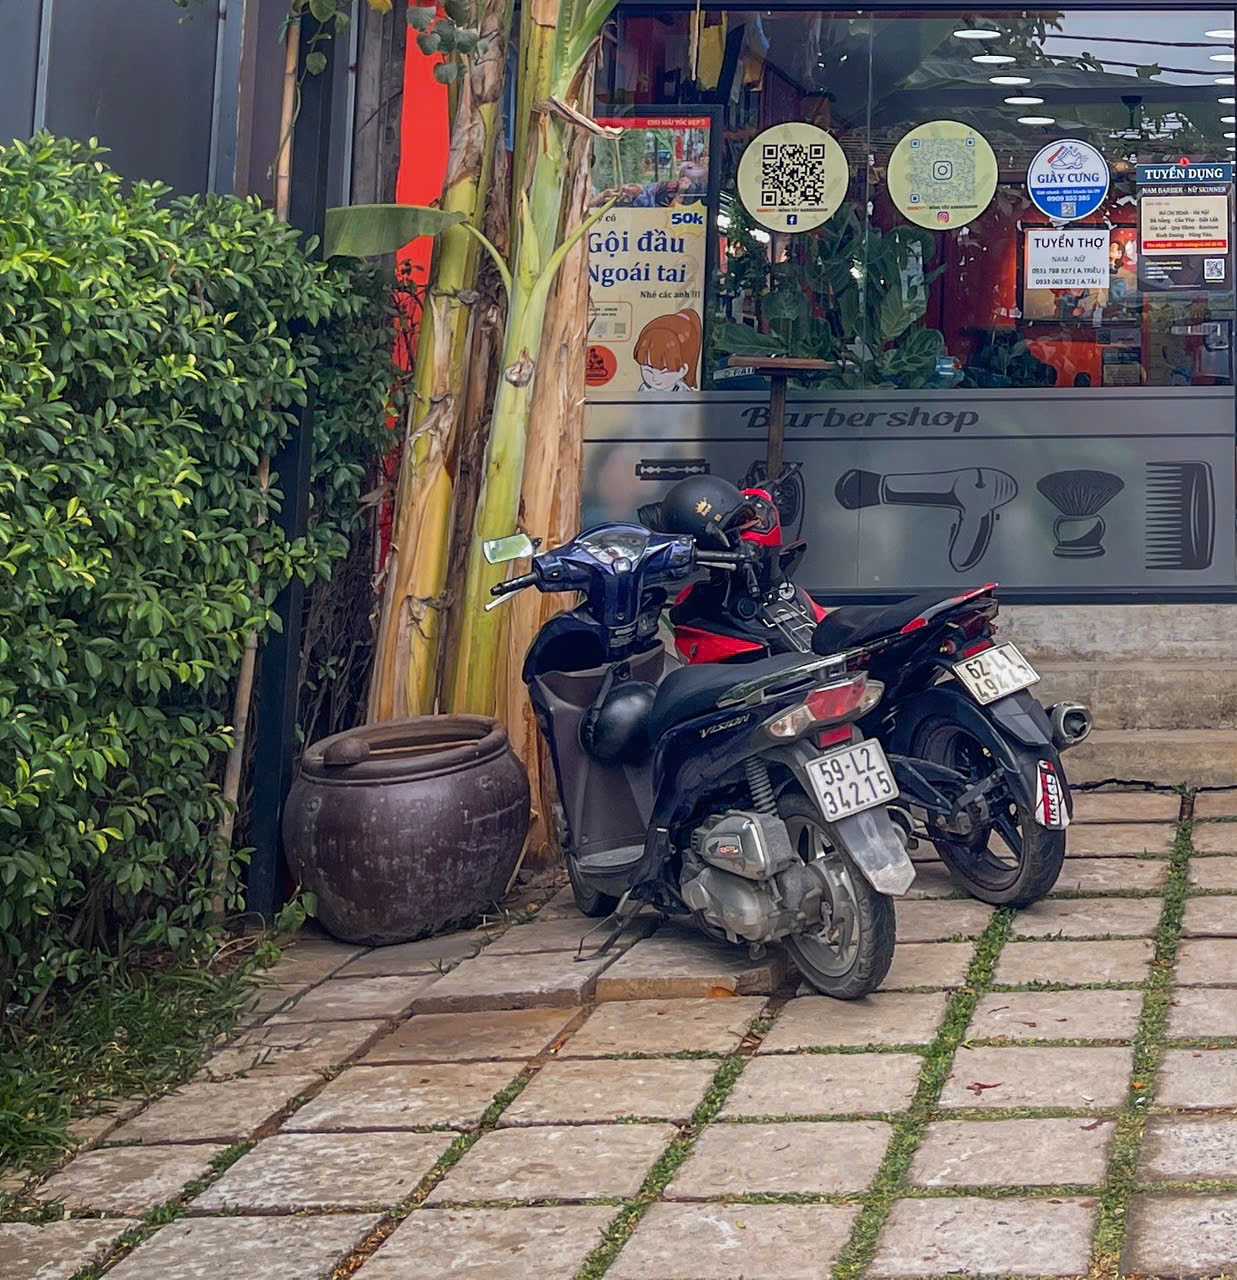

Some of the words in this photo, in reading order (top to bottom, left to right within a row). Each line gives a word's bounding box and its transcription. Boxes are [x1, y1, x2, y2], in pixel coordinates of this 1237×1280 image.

[1037, 171, 1066, 184] GIÀY
[1067, 172, 1100, 183] CƯNG
[1145, 166, 1185, 179] TUYỂN
[1188, 168, 1223, 181] DỤNG
[671, 213, 703, 225] 50k
[588, 230, 630, 258] Gội
[637, 228, 685, 254] đầu
[1034, 234, 1074, 249] TUYỂN
[1078, 237, 1105, 250] THỢ
[588, 261, 650, 288] Ngoái
[657, 264, 687, 283] tai
[640, 290, 657, 299] Nhé
[658, 290, 673, 299] các
[741, 406, 980, 433] Barbershop
[819, 747, 876, 786] 59-L2
[823, 770, 892, 815] 342.15
